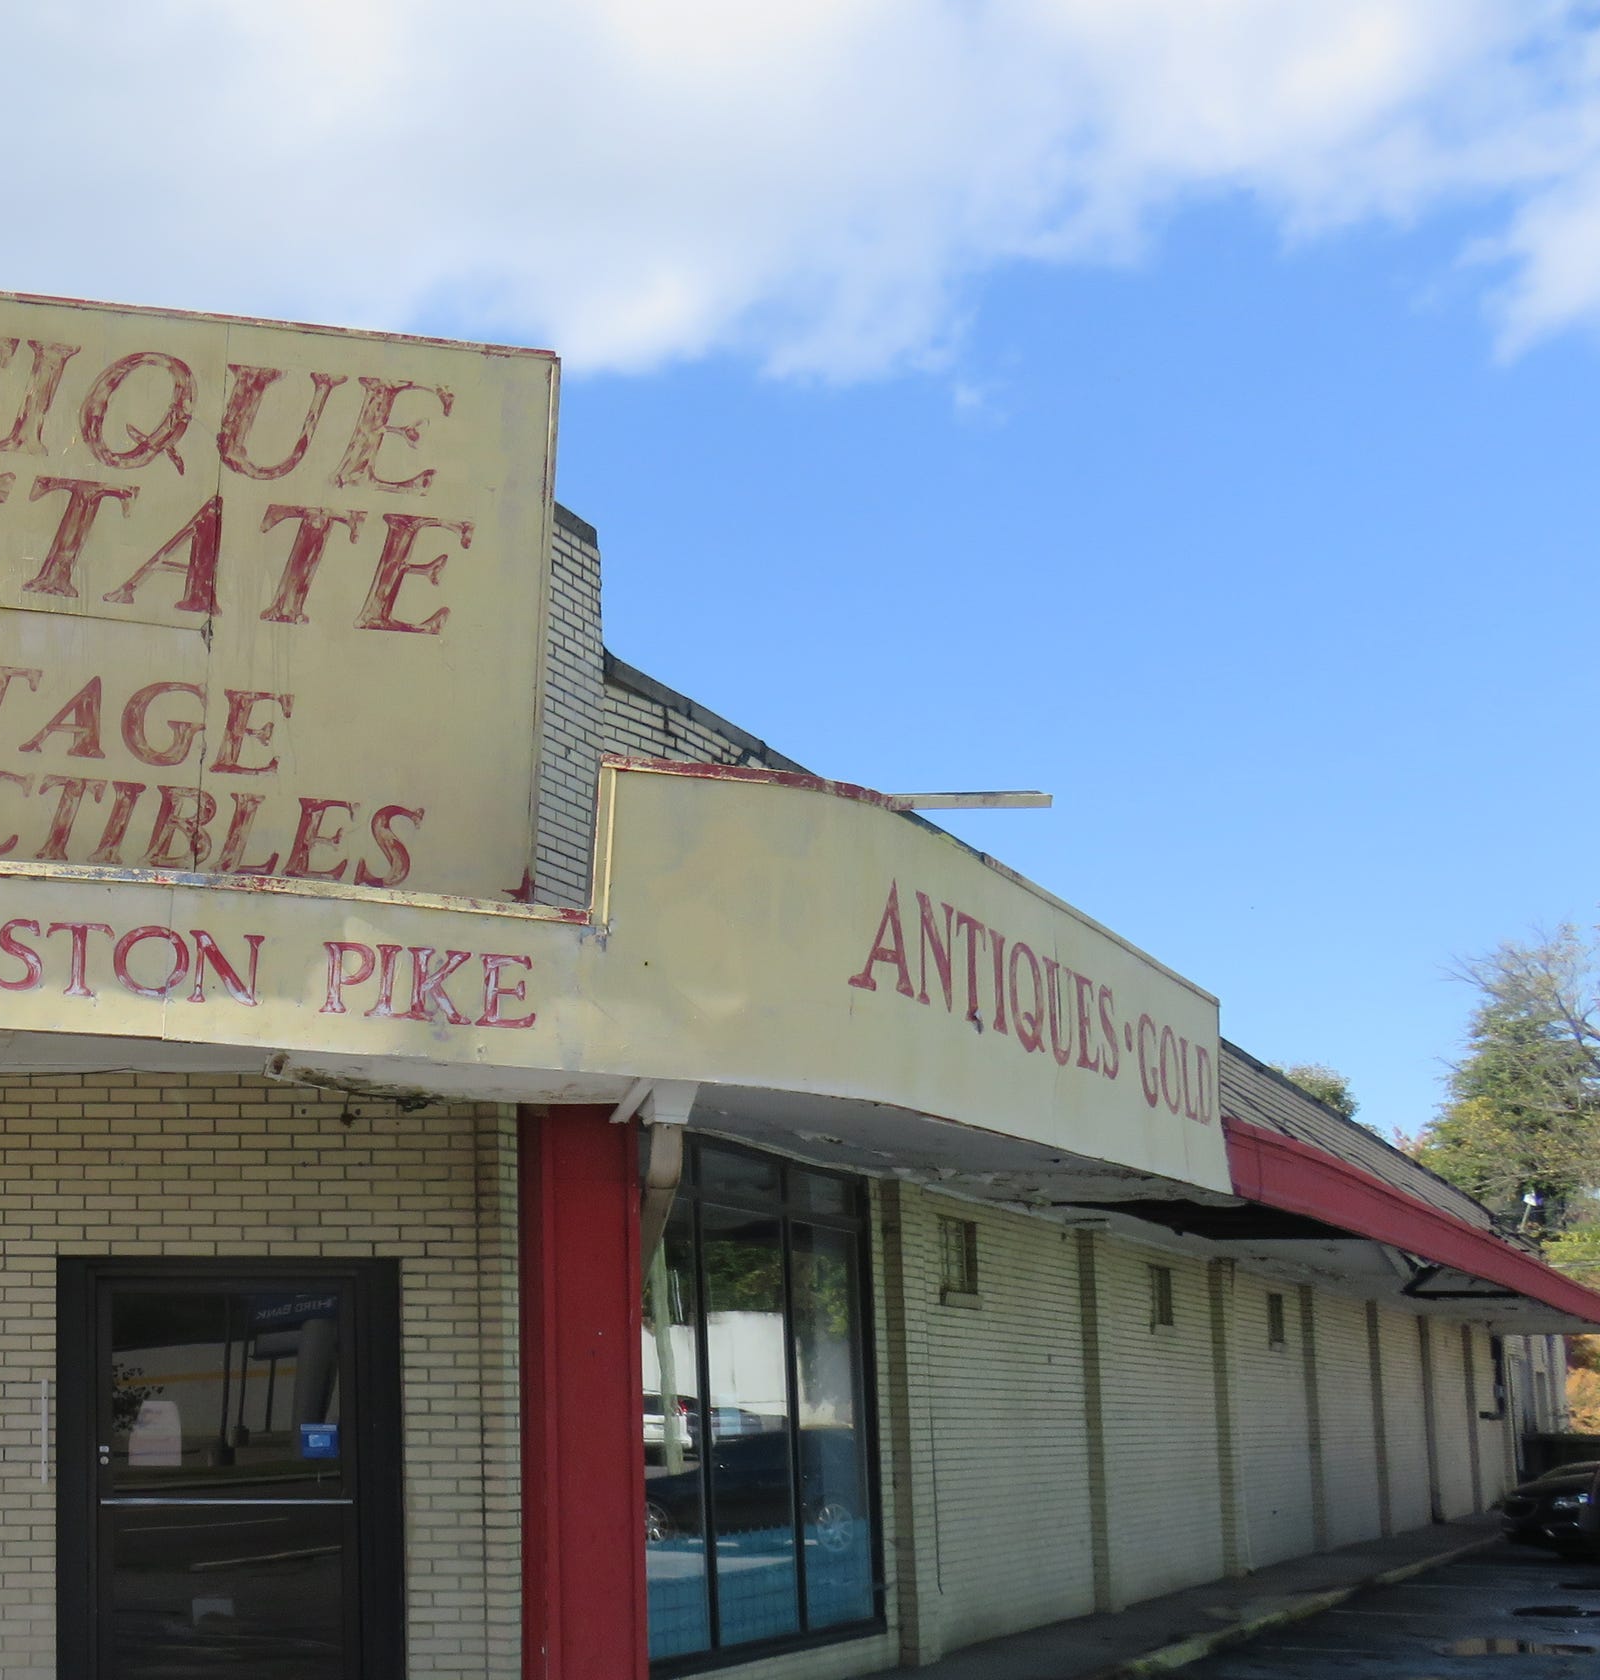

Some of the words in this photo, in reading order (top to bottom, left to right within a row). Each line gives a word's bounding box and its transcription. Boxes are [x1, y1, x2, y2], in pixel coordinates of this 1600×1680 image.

[320, 940, 537, 1029] PIKE
[849, 877, 1119, 1080] ANTIQUES
[1137, 1013, 1212, 1126] GOLD
